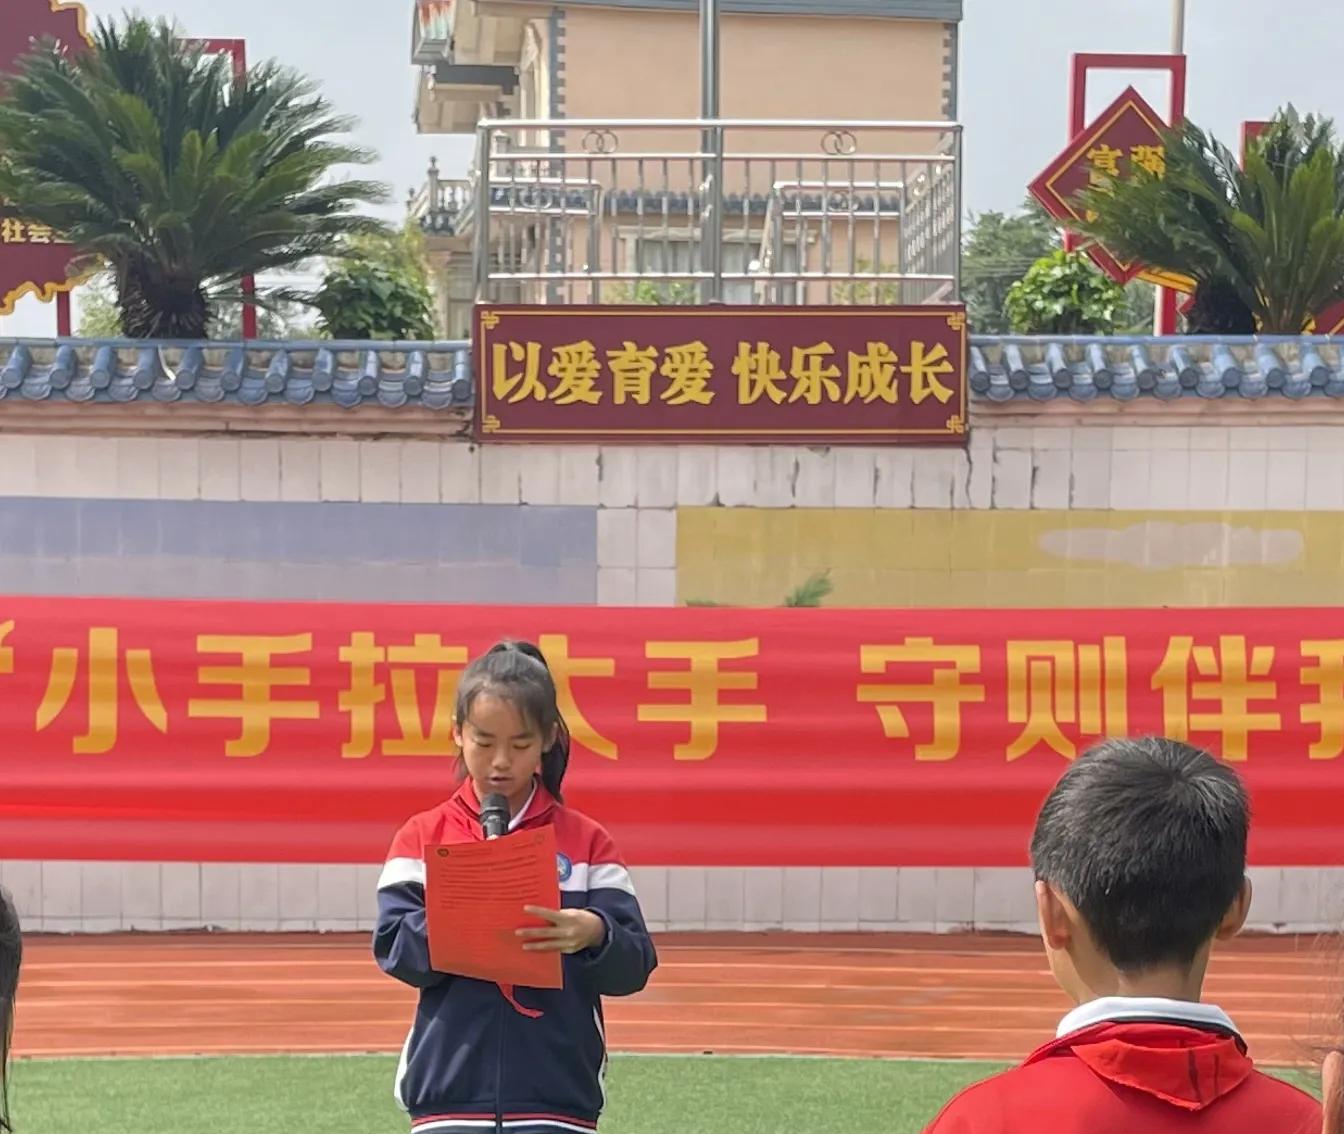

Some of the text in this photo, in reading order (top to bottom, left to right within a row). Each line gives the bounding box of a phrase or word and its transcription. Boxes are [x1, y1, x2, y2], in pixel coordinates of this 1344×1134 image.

[491, 340, 955, 405] 以爱育爱 快乐成长
